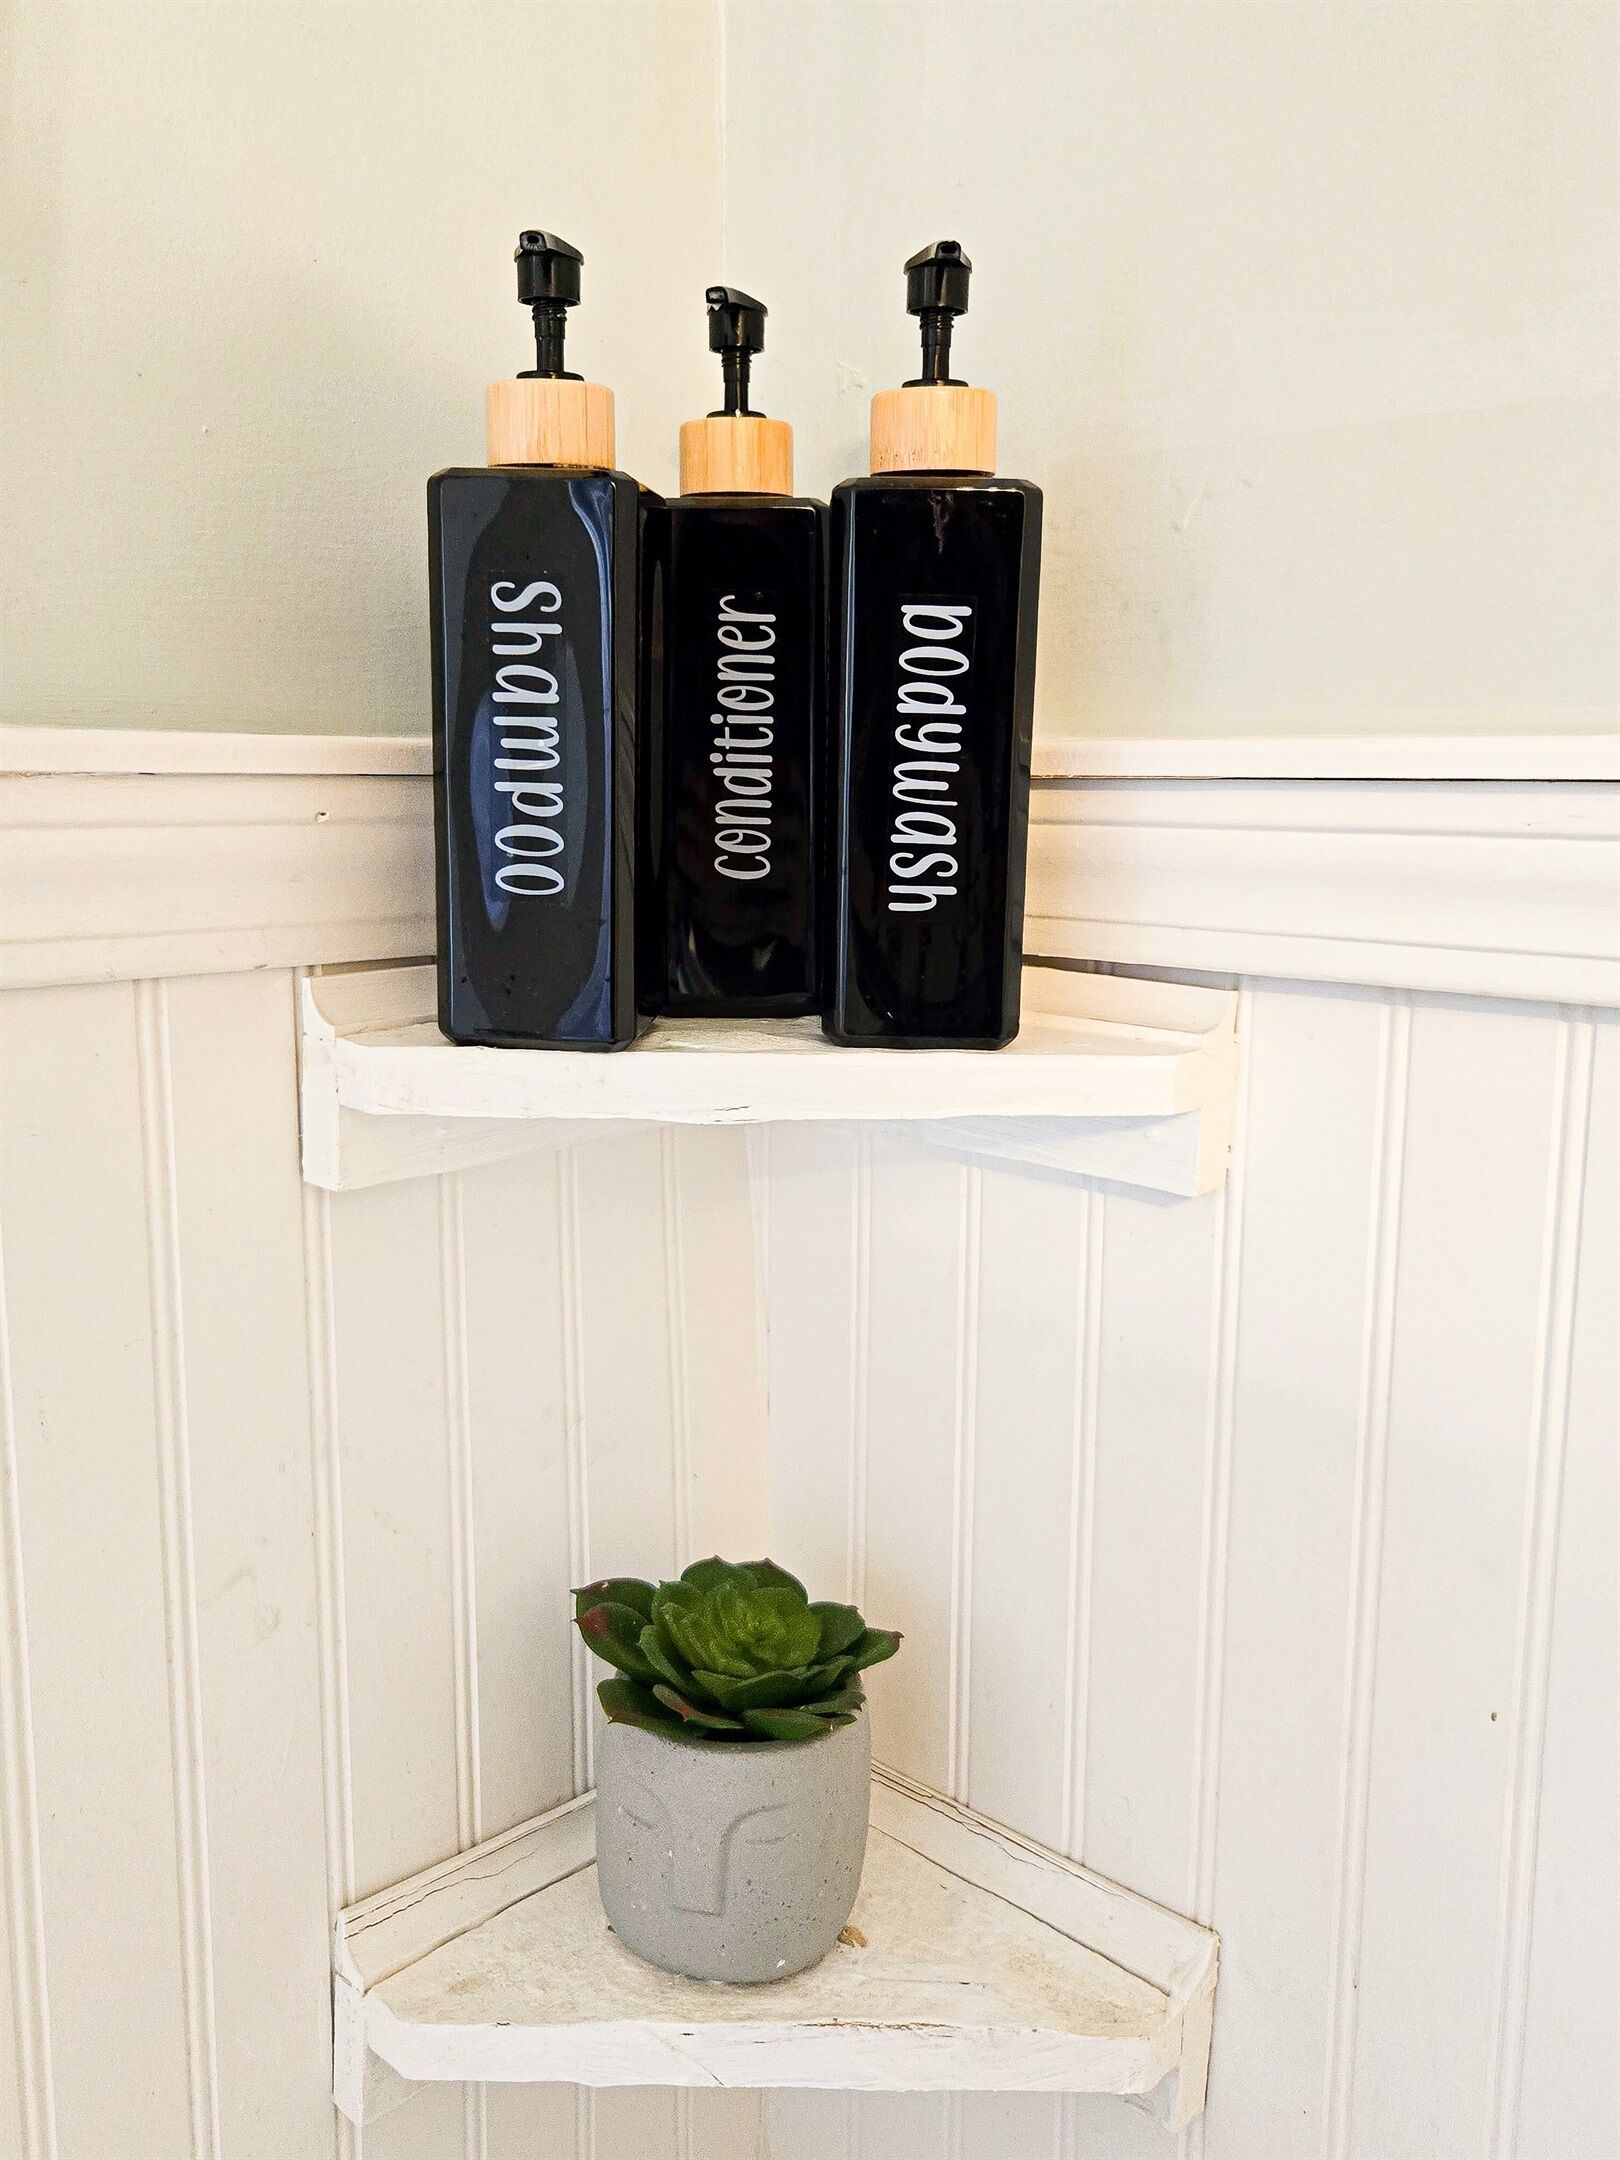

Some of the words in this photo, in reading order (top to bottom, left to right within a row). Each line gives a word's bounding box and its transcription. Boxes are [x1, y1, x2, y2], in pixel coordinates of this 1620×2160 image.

[490, 580, 565, 896] shampoo
[710, 594, 777, 880] conditioner
[887, 604, 973, 913] bodywash
